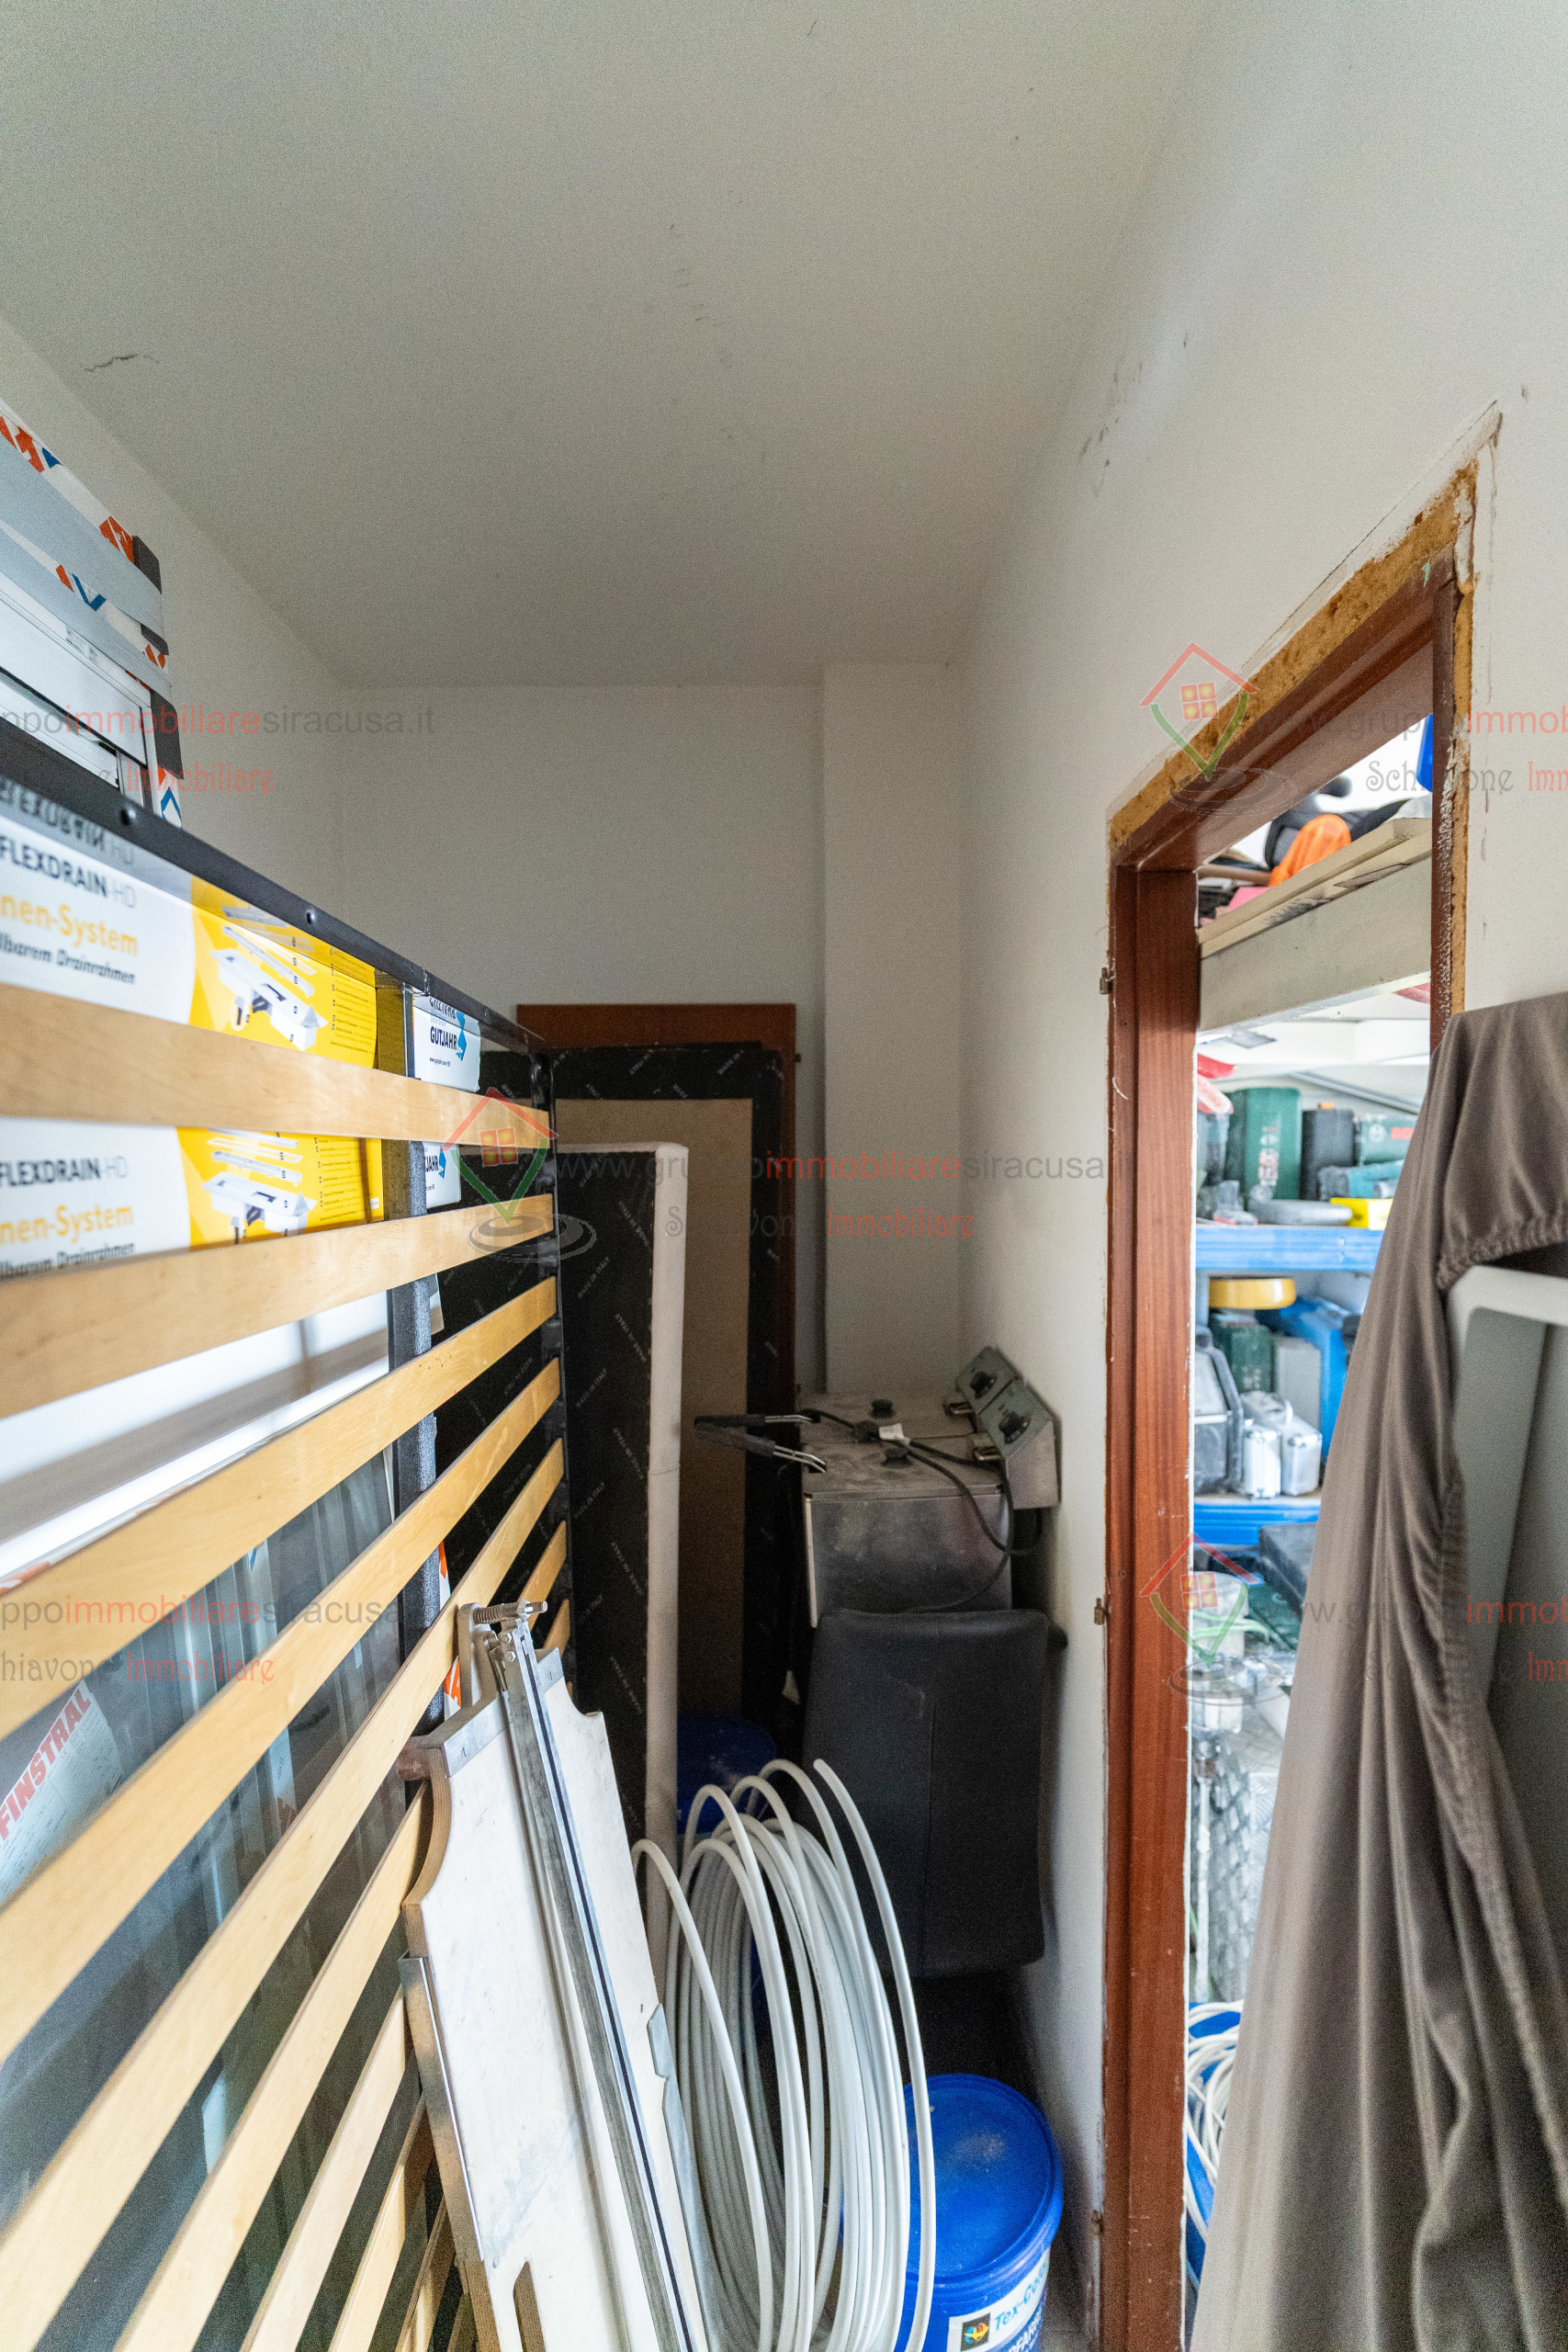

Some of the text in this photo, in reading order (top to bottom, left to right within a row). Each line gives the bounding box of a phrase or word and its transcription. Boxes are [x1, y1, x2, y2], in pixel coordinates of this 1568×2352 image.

[430, 1025, 457, 1051] GUTJAHR
[0, 1689, 91, 1839] FINSTRAL
[995, 2260, 1046, 2331] Tex-Co
